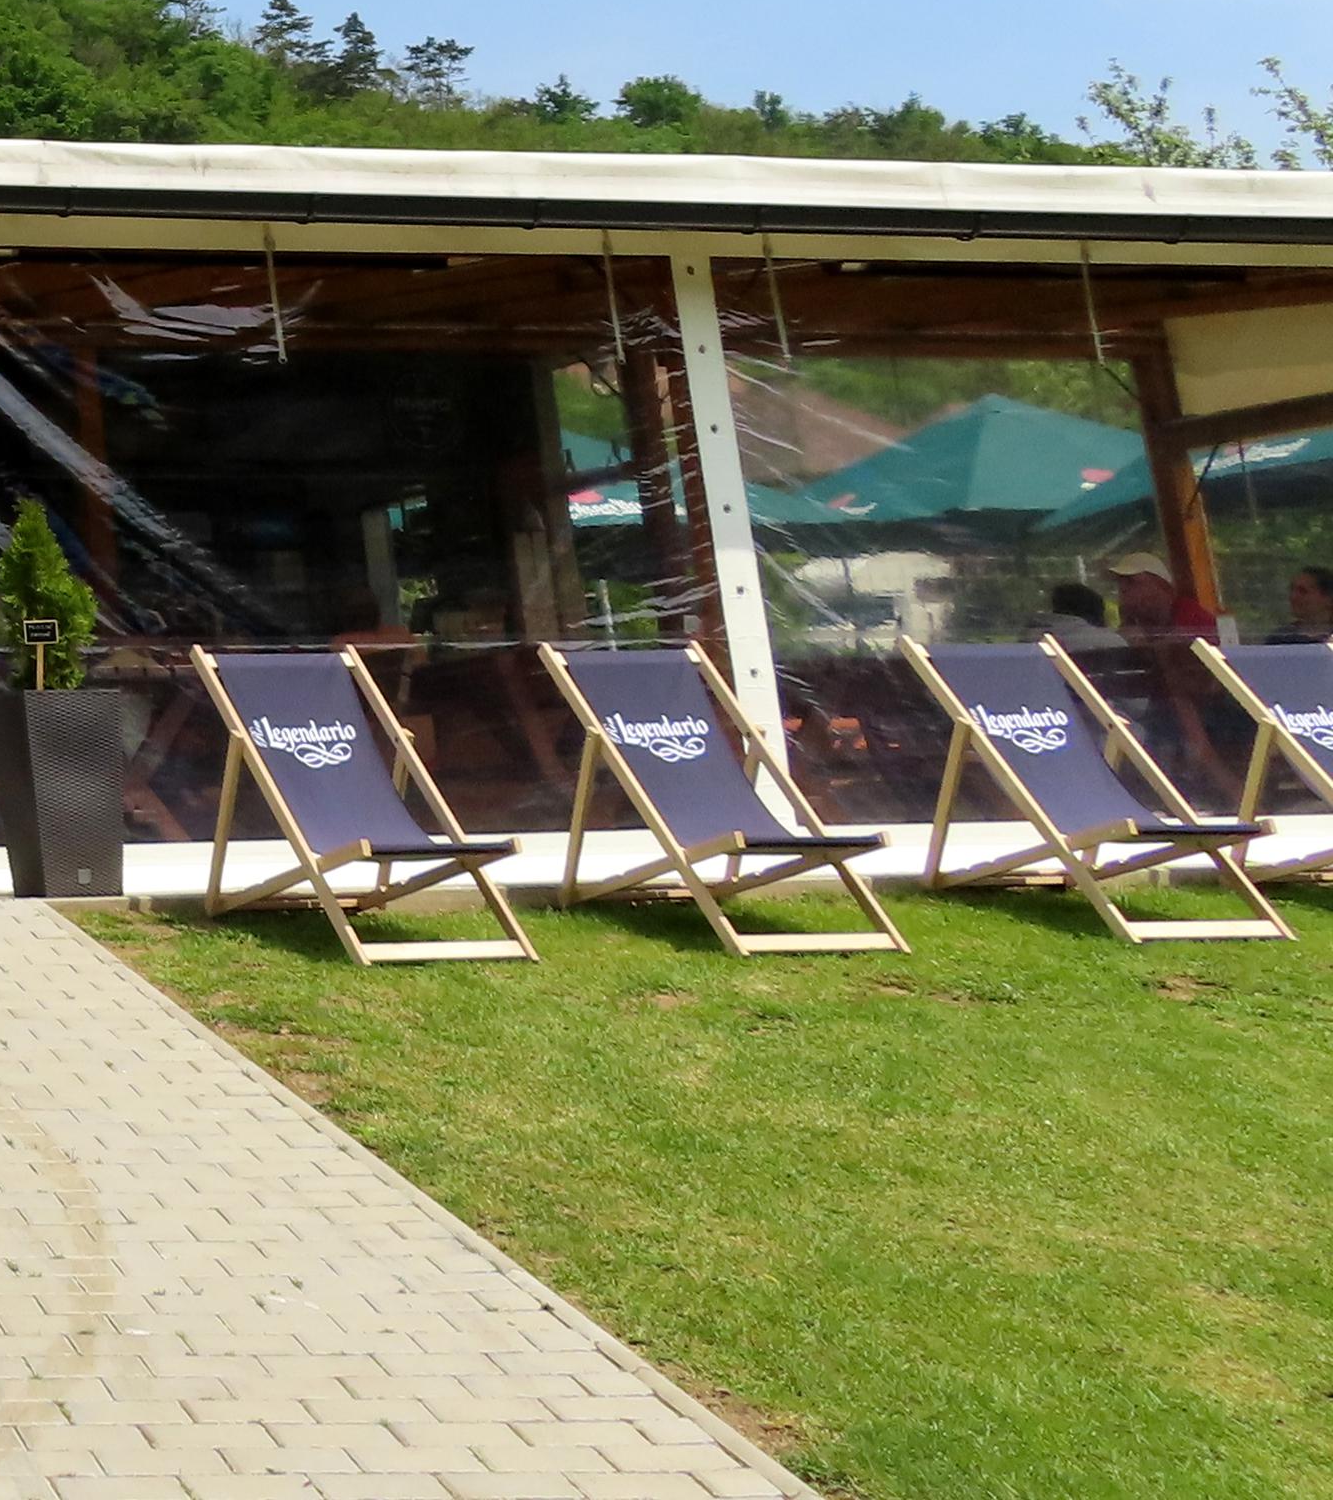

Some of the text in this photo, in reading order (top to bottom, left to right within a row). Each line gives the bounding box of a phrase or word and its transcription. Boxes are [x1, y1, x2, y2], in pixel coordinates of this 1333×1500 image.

[261, 715, 356, 752] Legendario
[613, 712, 709, 748] Legendario
[976, 704, 1068, 739] Legendario
